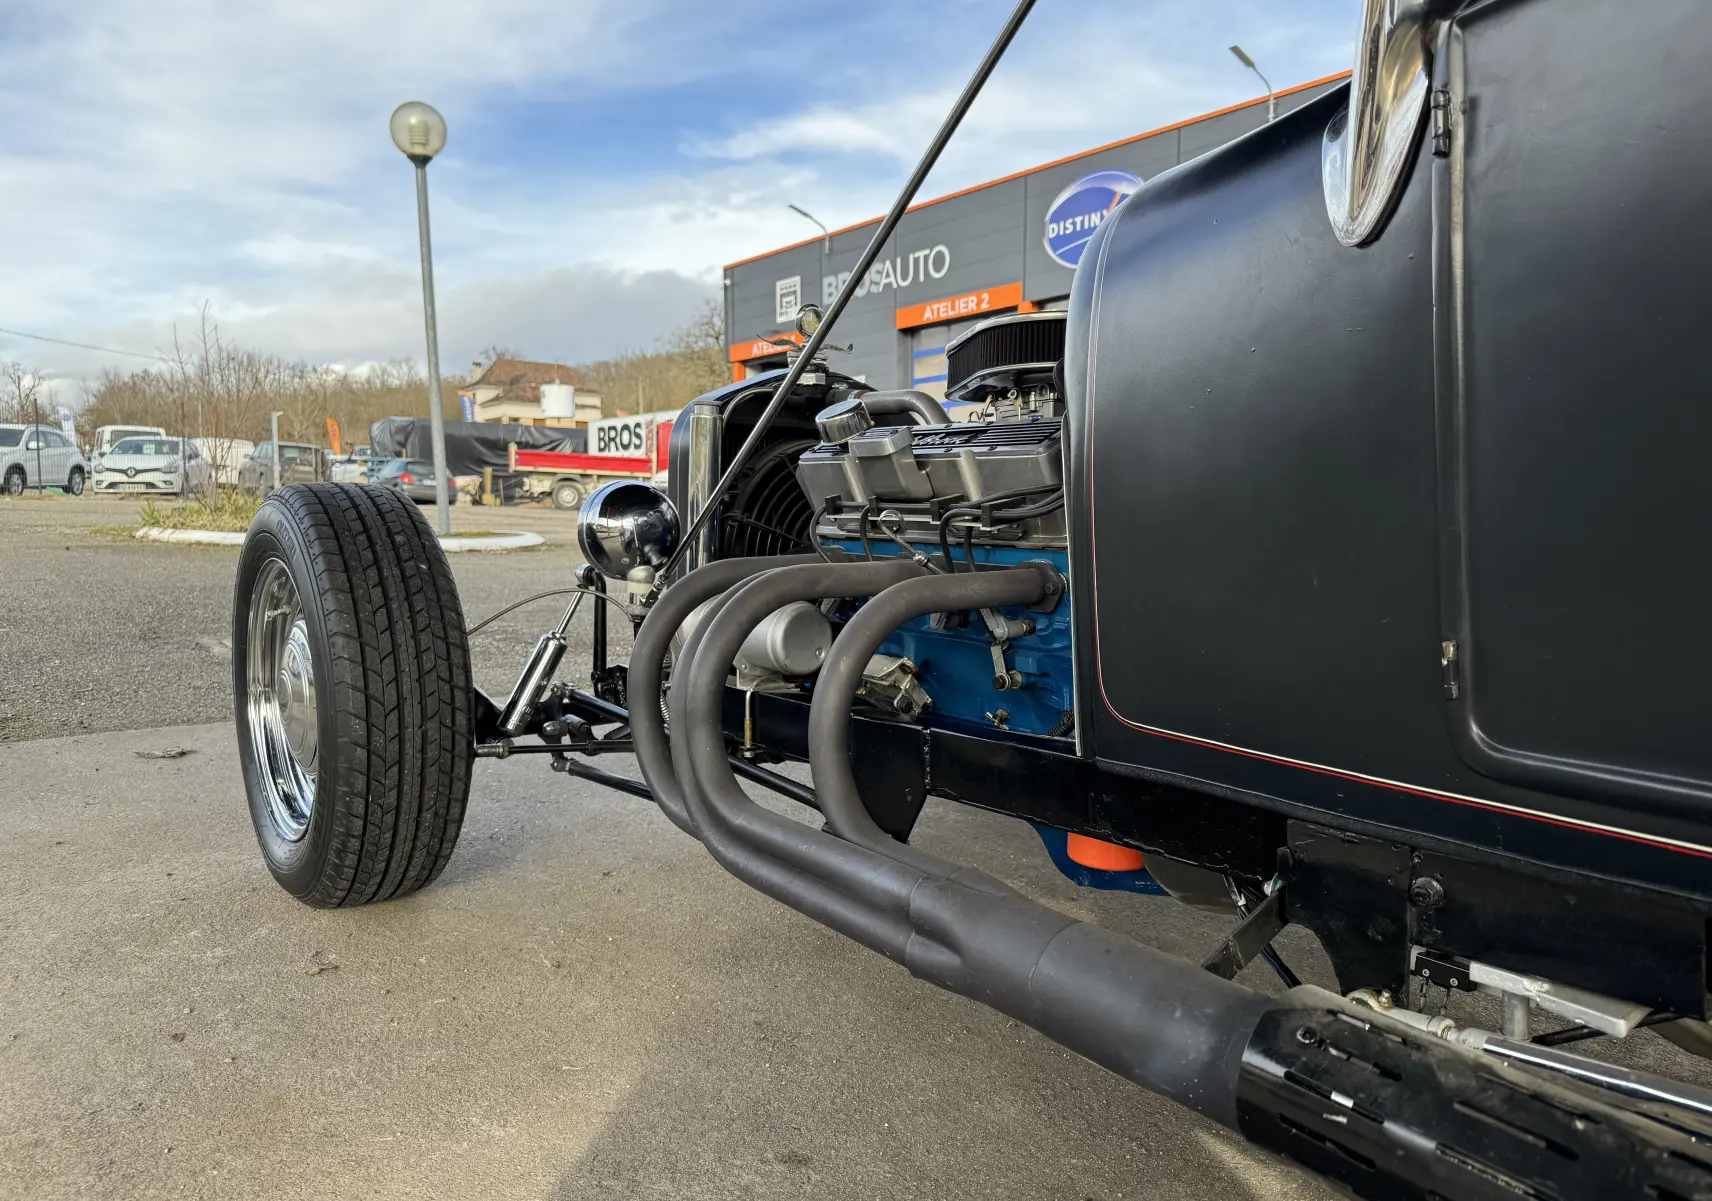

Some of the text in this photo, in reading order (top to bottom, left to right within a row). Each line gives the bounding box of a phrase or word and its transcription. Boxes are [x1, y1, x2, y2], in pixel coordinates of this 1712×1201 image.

[923, 293, 989, 321] ATELIER 2
[751, 336, 789, 357] ATEL
[598, 422, 642, 453] BROS
